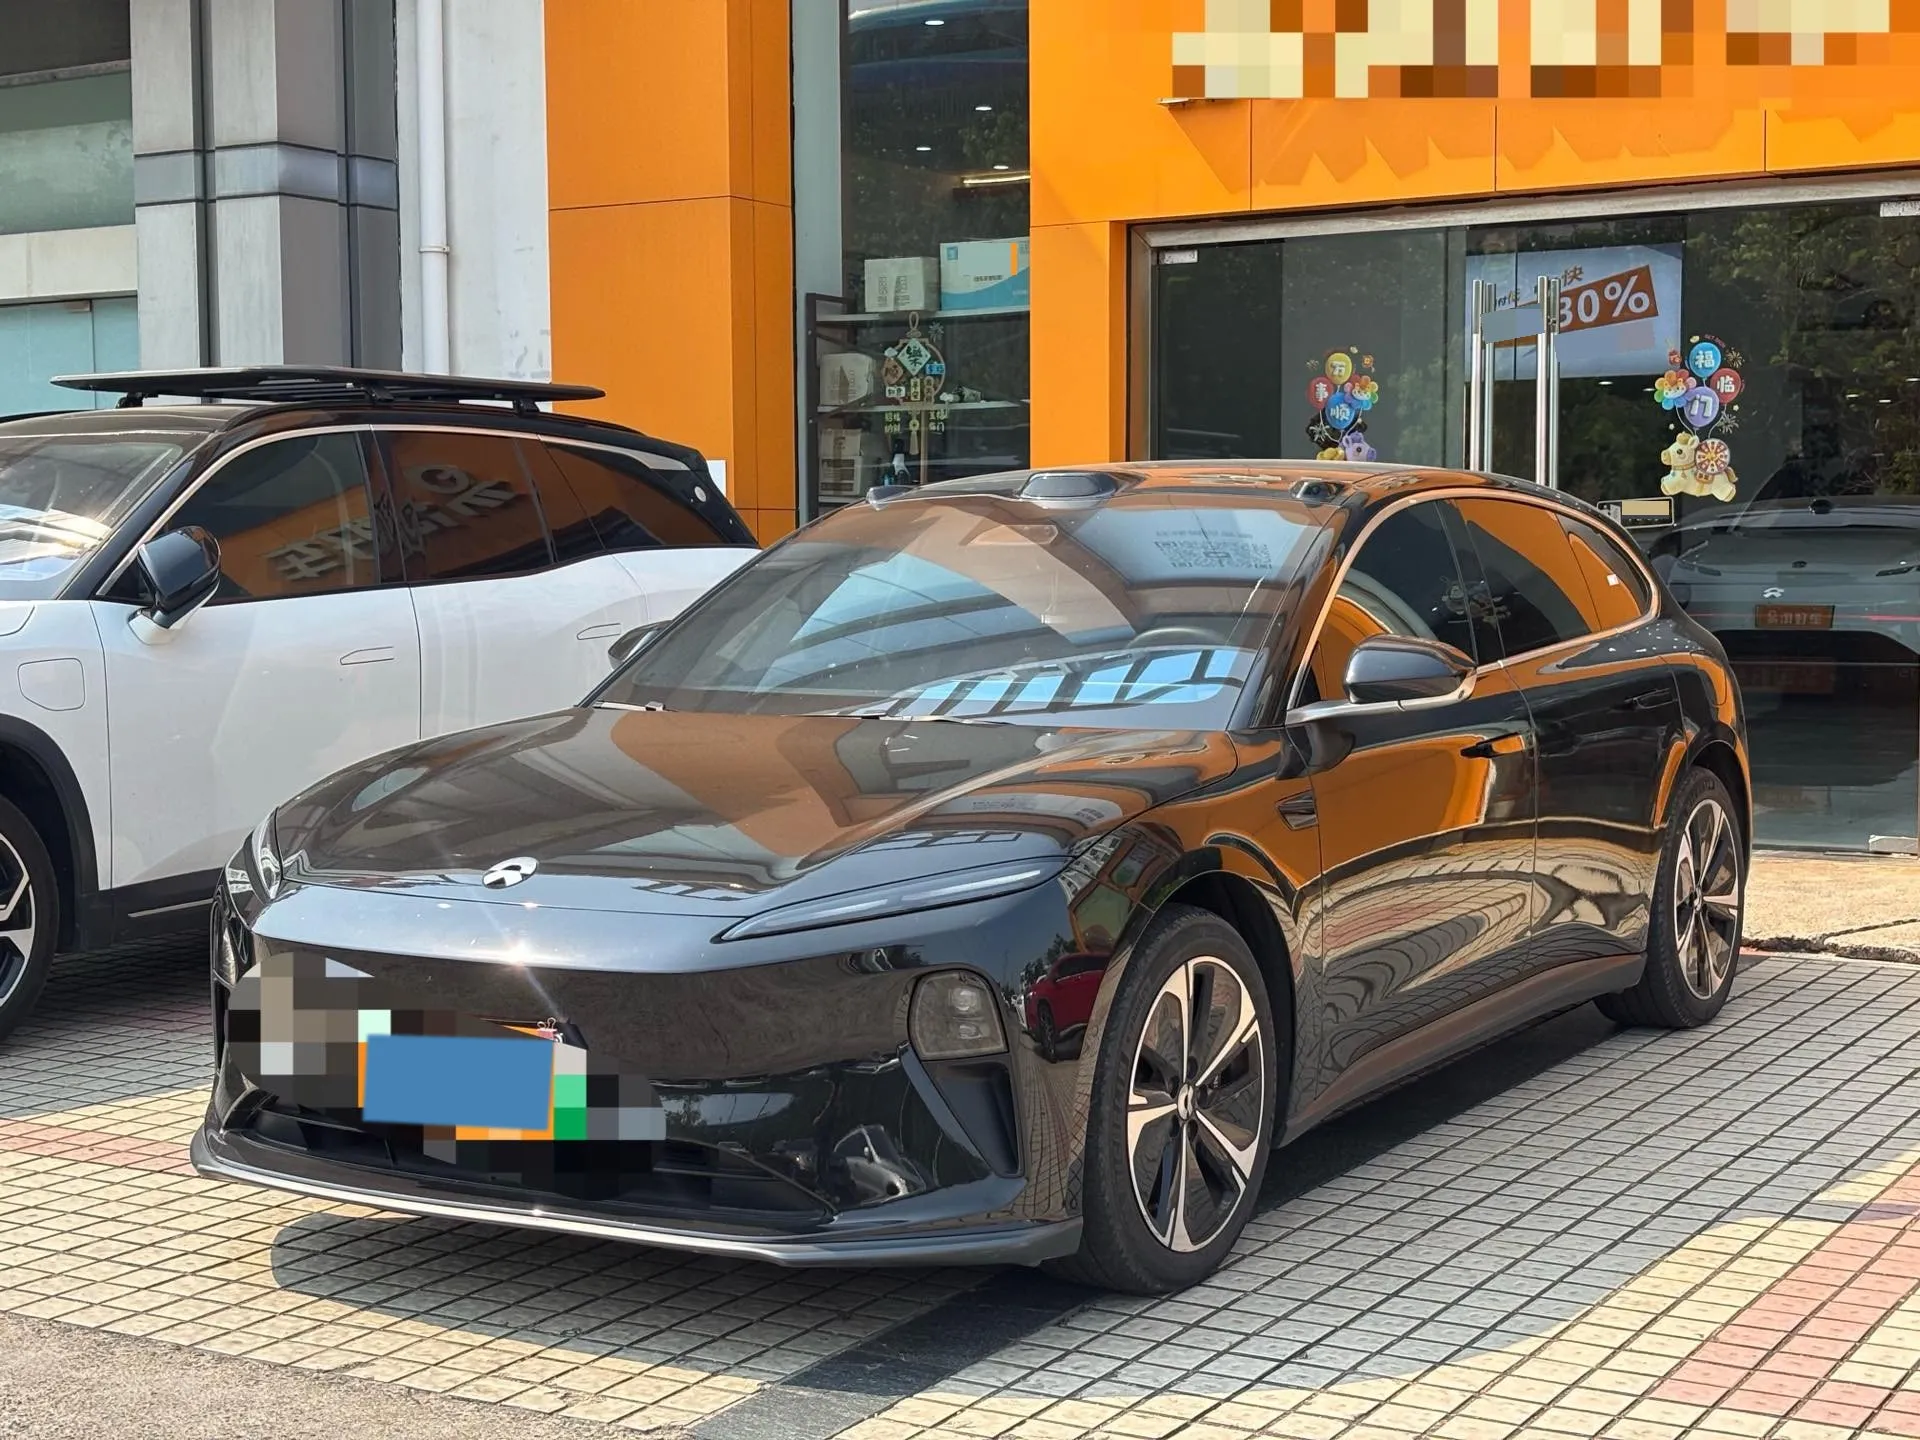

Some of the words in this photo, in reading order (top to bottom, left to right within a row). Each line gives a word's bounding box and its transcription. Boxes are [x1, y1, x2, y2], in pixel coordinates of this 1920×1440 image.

[1694, 350, 1715, 369] 福
[1314, 382, 1329, 402] 事
[1716, 375, 1736, 394] 临
[1329, 402, 1351, 422] 顺
[1689, 393, 1714, 418] 门
